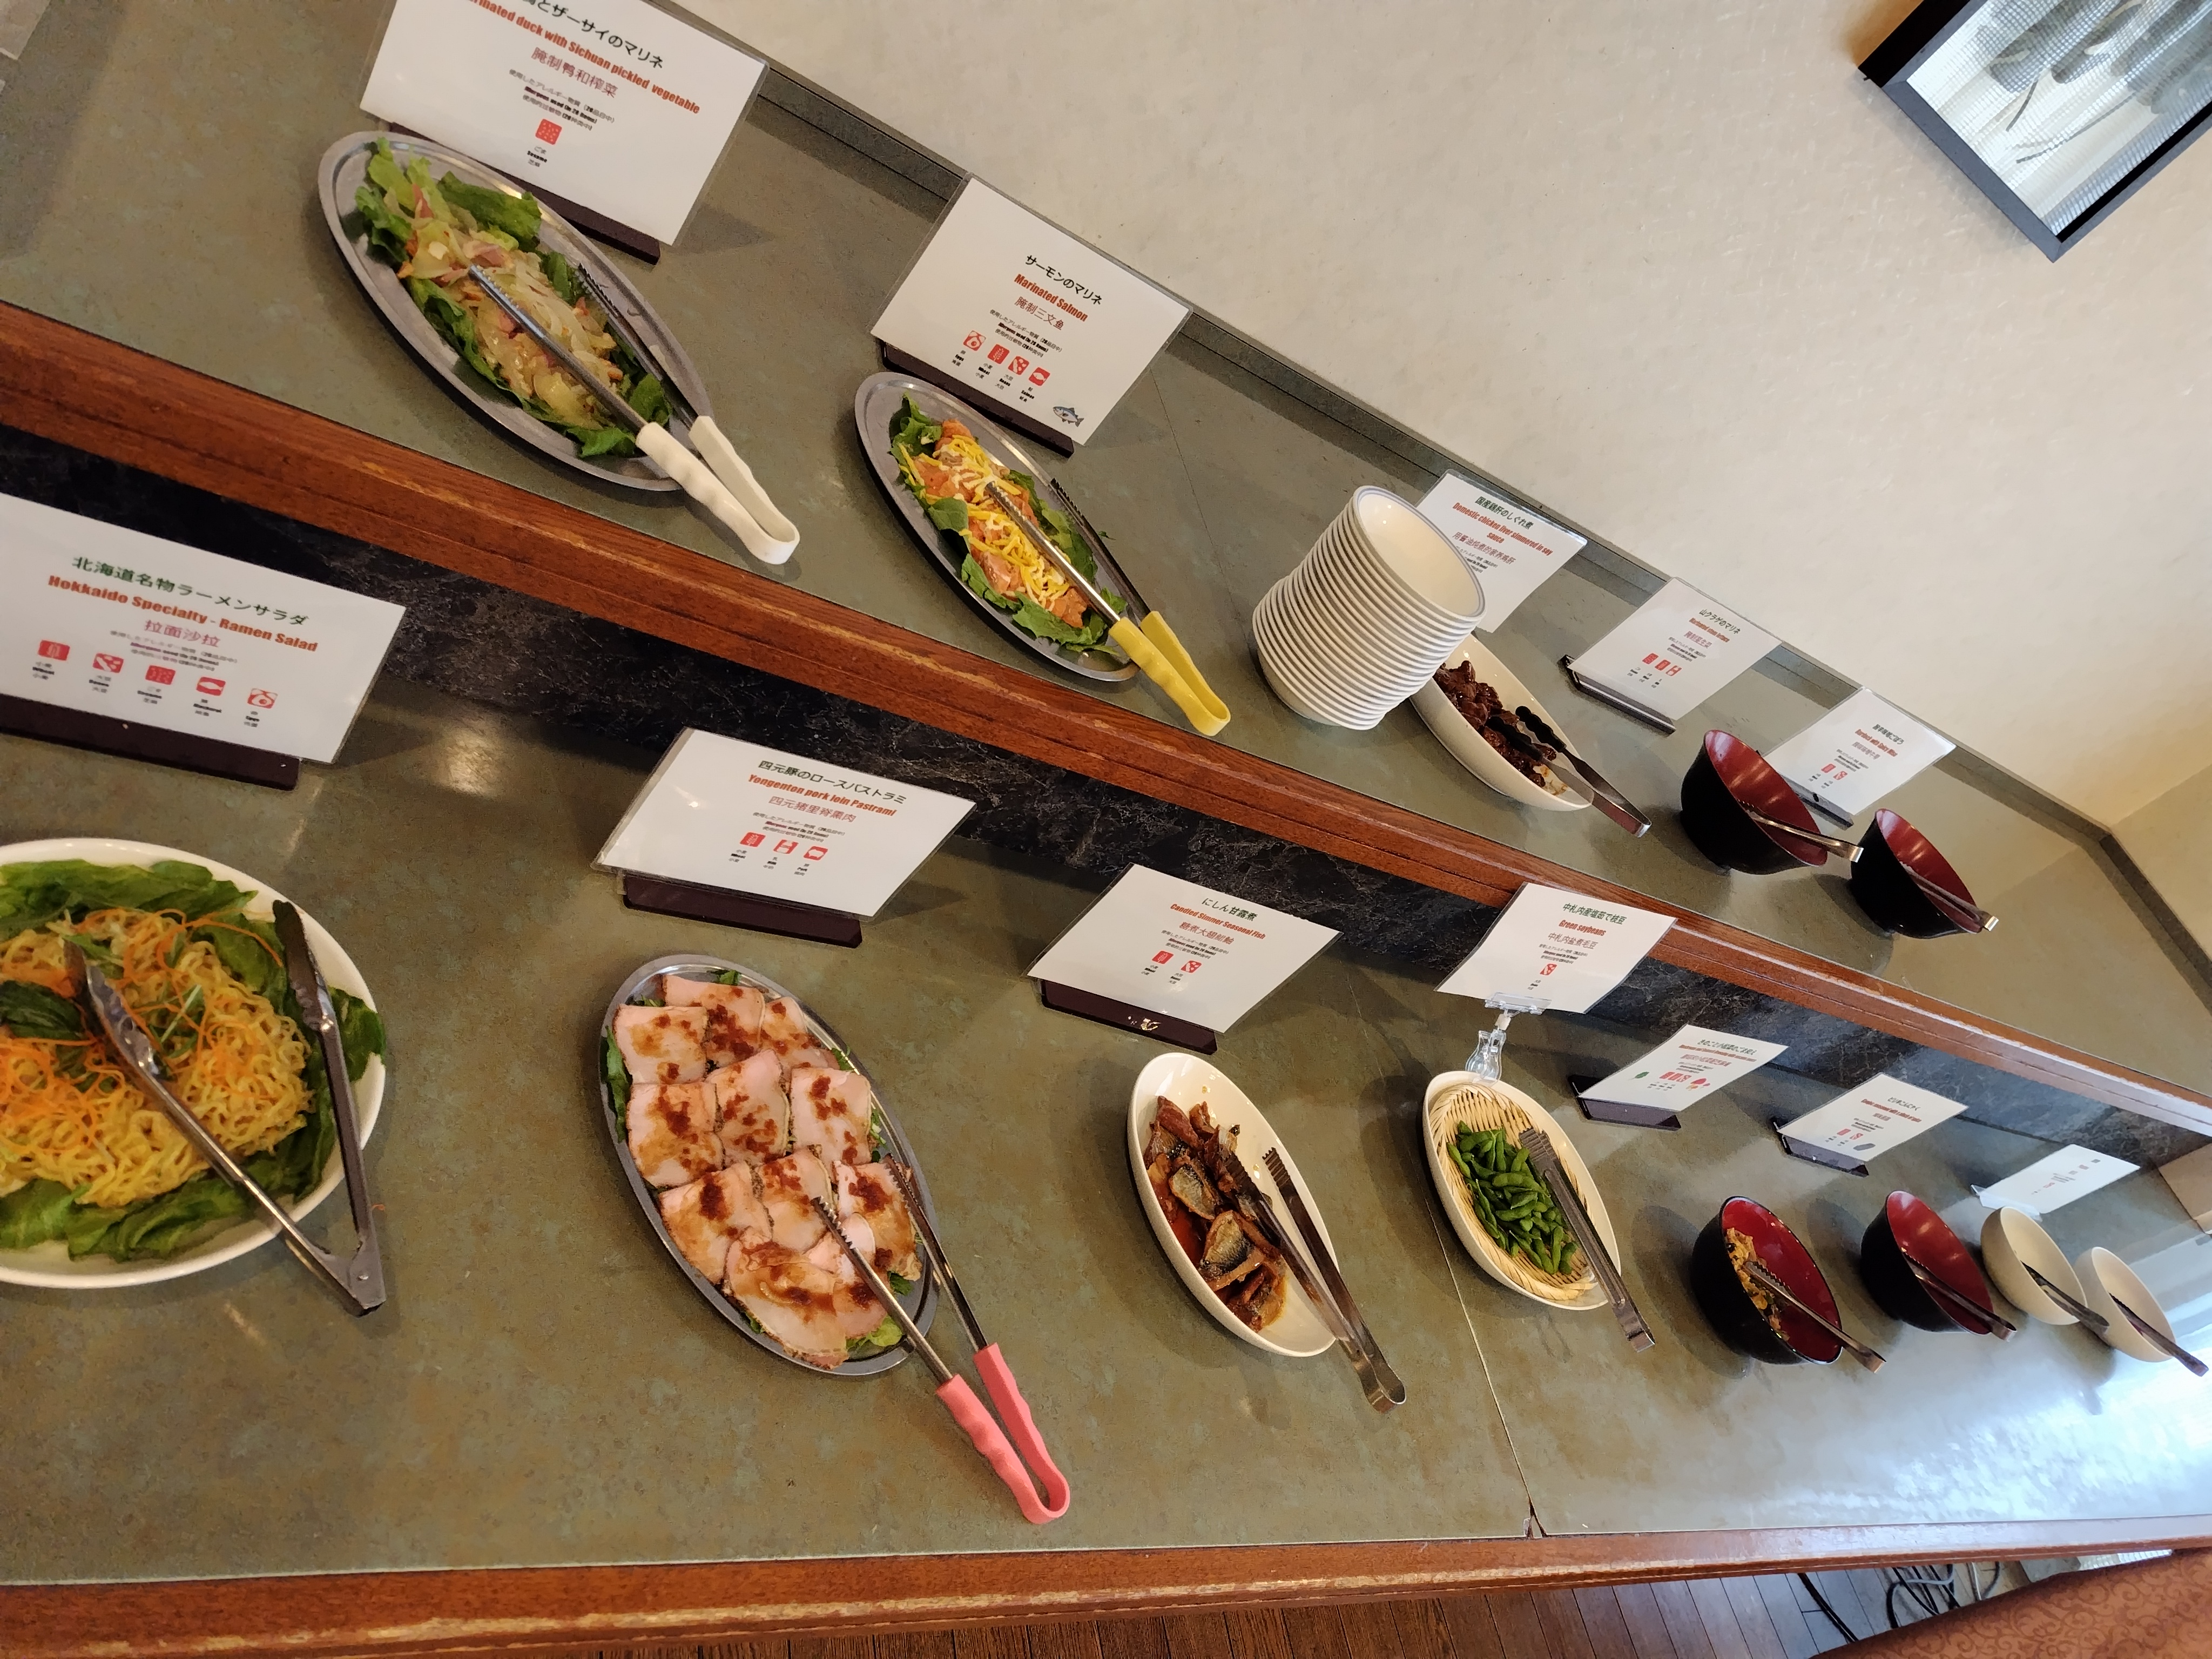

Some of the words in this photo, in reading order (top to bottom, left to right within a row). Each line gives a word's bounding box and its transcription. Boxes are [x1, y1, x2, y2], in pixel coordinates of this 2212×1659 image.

[516, 16, 543, 36] duck
[544, 30, 568, 48] with
[568, 41, 611, 70] Sichuan
[610, 64, 650, 89] pickled
[651, 84, 699, 113] vegetable
[1014, 273, 1058, 304] Marinated
[1056, 298, 1088, 321] Salmon
[1025, 255, 1102, 305] サーモンのマリネ
[1014, 296, 1063, 330] 腌制三文鱼
[1452, 502, 1480, 519] Domestic
[1478, 516, 1501, 530] chicken
[1498, 525, 1513, 535] liver
[1510, 532, 1539, 548] simmered
[1541, 548, 1553, 556] soy
[1474, 496, 1534, 529] 国産鶏肝のしぐれ煮
[1486, 532, 1504, 543] sauce
[72, 557, 308, 625] 北海道名物ラーメンサラダ
[48, 575, 128, 603] Hokkaido
[132, 596, 207, 624] Specialty
[219, 618, 272, 640] Ramen
[274, 633, 318, 651] Salad
[1698, 609, 1740, 634] 山クラゲのマリネ
[144, 619, 220, 647] 拉面沙拉
[748, 774, 805, 794] Yongenton
[804, 790, 830, 800] pork
[829, 794, 851, 805] loin
[849, 799, 897, 816] Pastrami
[1170, 903, 1199, 916] Candied
[1197, 913, 1224, 925] Simmer
[1222, 921, 1253, 935] Seasonal
[1251, 930, 1265, 939] Fish
[1202, 898, 1257, 921] にしん甘露煮
[1562, 903, 1627, 925] 中札内産塩茹で枝豆
[1559, 919, 1578, 929] Green
[1576, 925, 1606, 936] soybeans
